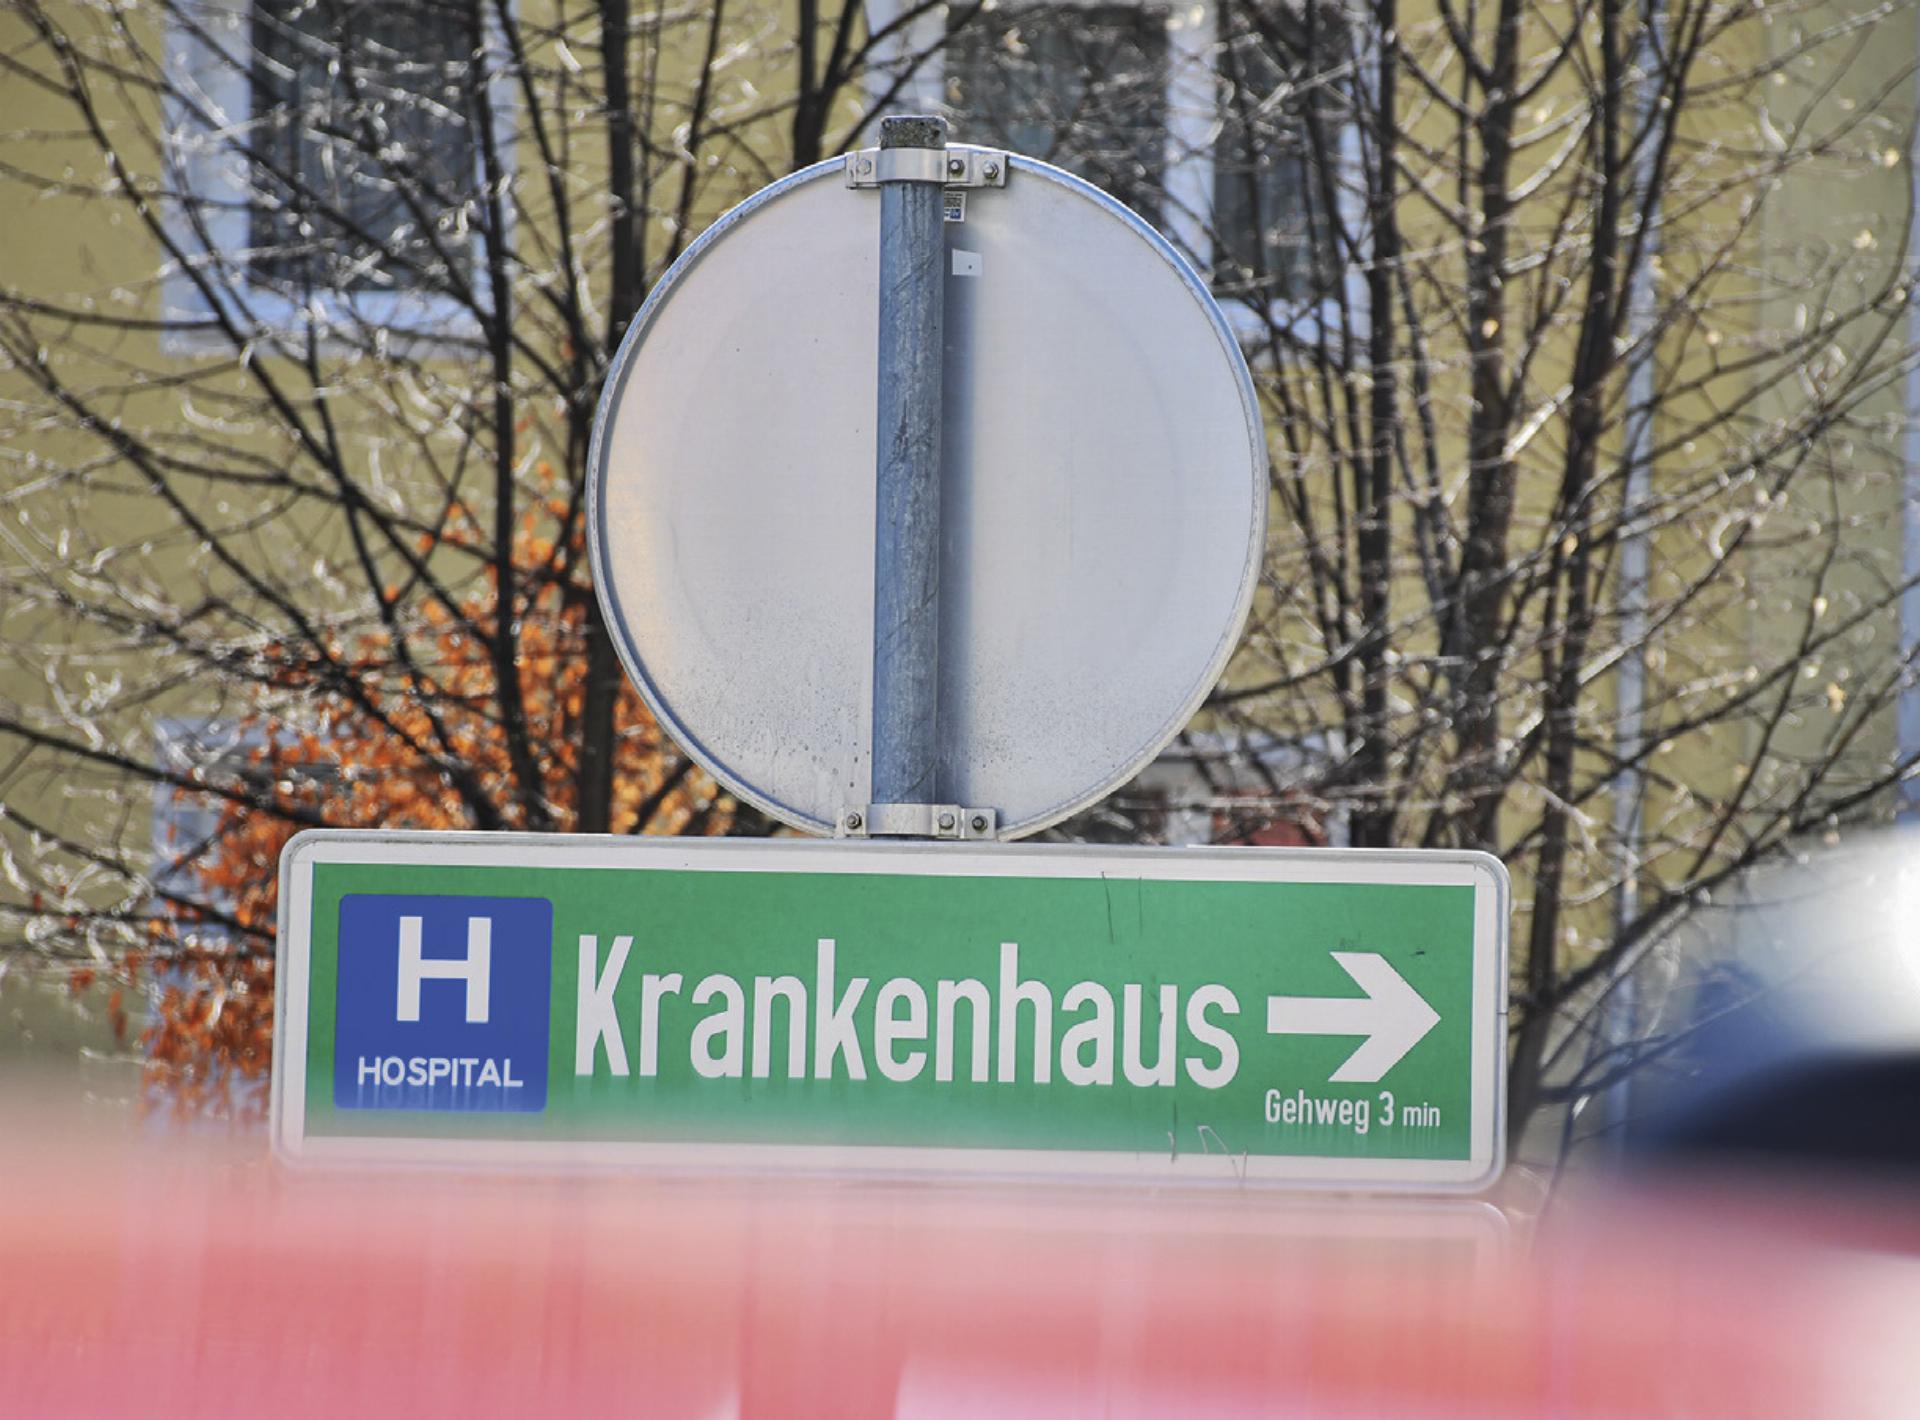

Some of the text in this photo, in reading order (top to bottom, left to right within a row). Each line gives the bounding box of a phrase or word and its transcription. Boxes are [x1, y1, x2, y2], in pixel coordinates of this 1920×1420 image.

[396, 915, 492, 1024] H
[575, 934, 1241, 1090] Krankenhaus
[356, 1056, 524, 1089] HOSPITAL
[1264, 1088, 1441, 1135] Gehweg 3 min
